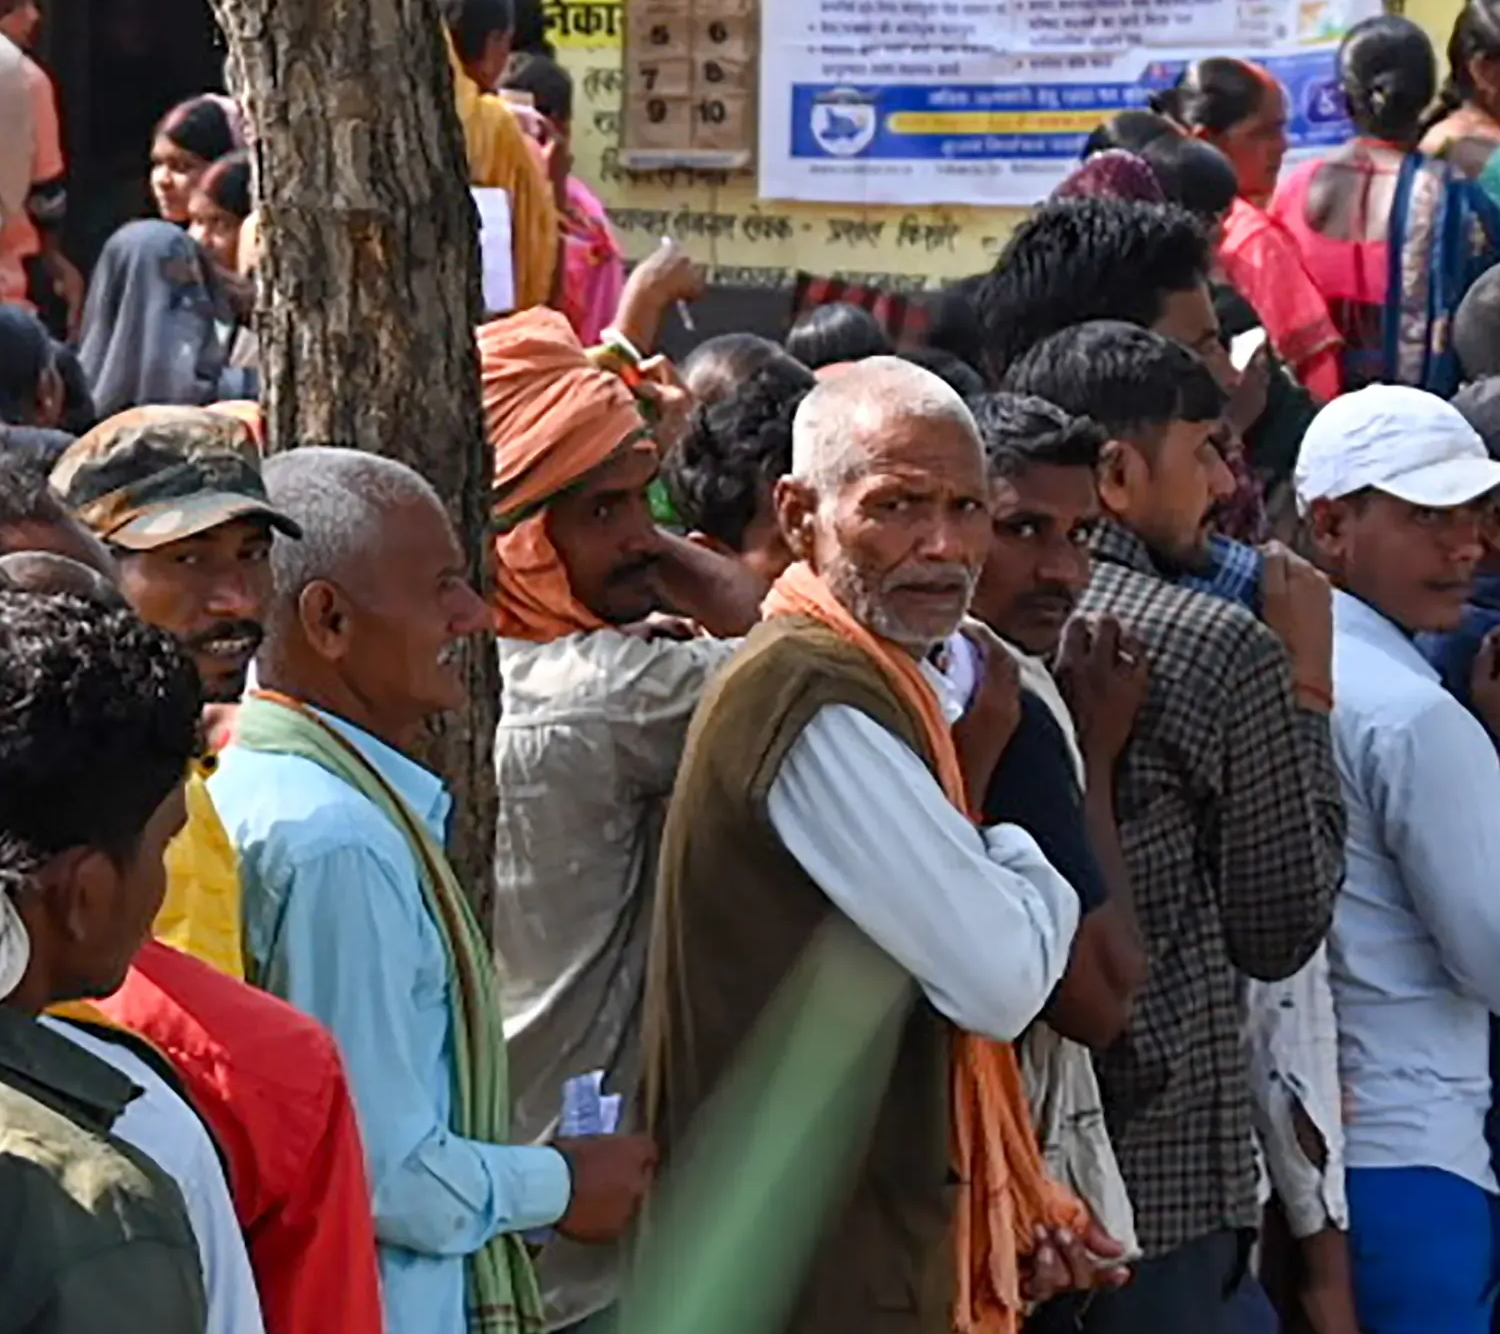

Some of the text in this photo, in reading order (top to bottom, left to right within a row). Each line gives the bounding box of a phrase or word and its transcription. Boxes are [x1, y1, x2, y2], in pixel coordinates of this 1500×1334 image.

[708, 21, 728, 44] 6
[640, 67, 659, 90] 7
[700, 99, 727, 124] 10
